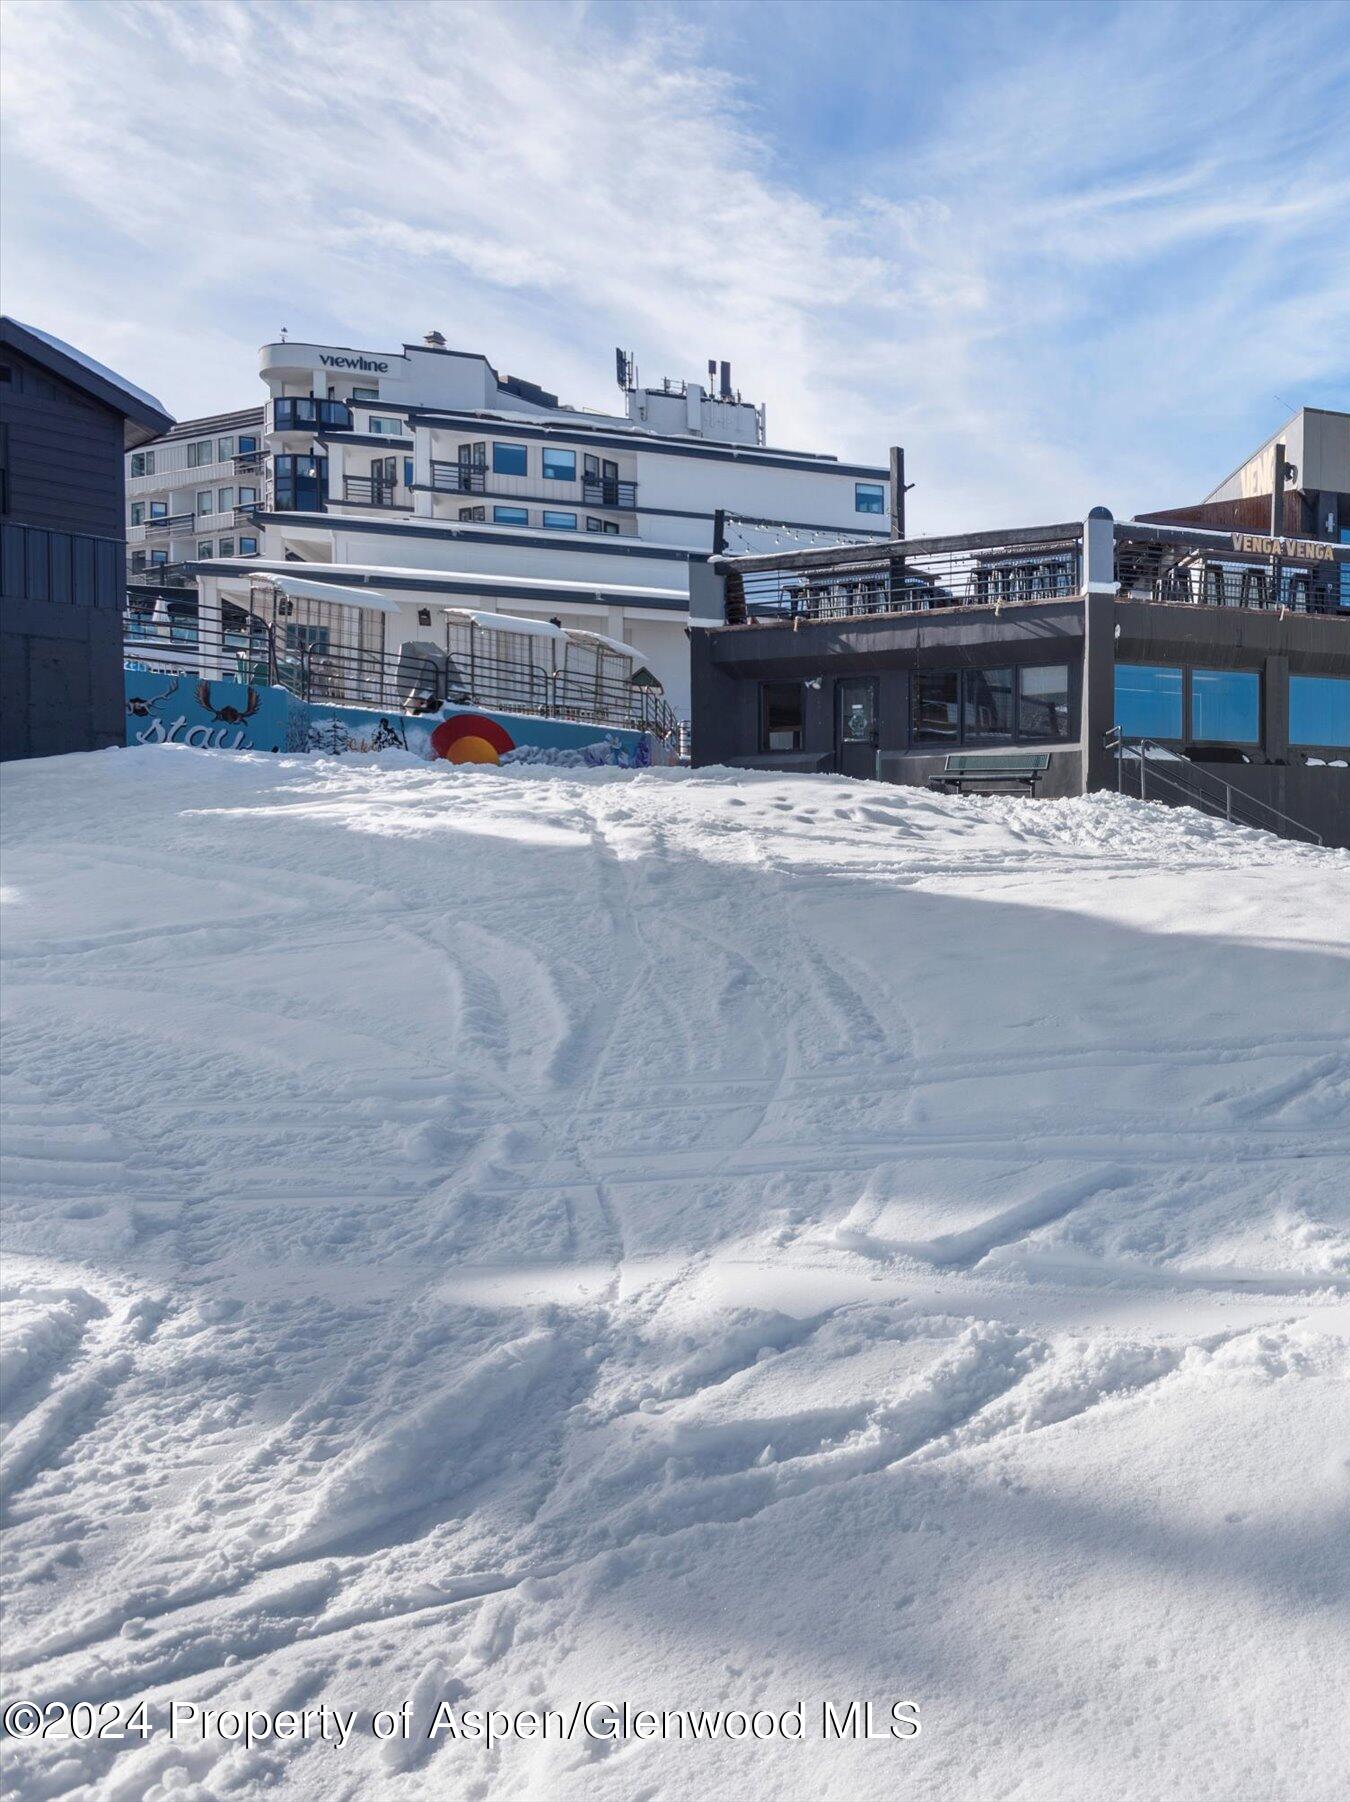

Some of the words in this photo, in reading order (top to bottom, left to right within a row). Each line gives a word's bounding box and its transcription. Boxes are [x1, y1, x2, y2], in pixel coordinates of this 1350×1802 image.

[319, 354, 389, 373] viewline
[1231, 532, 1281, 554] VENGA
[1286, 539, 1334, 561] VENGA
